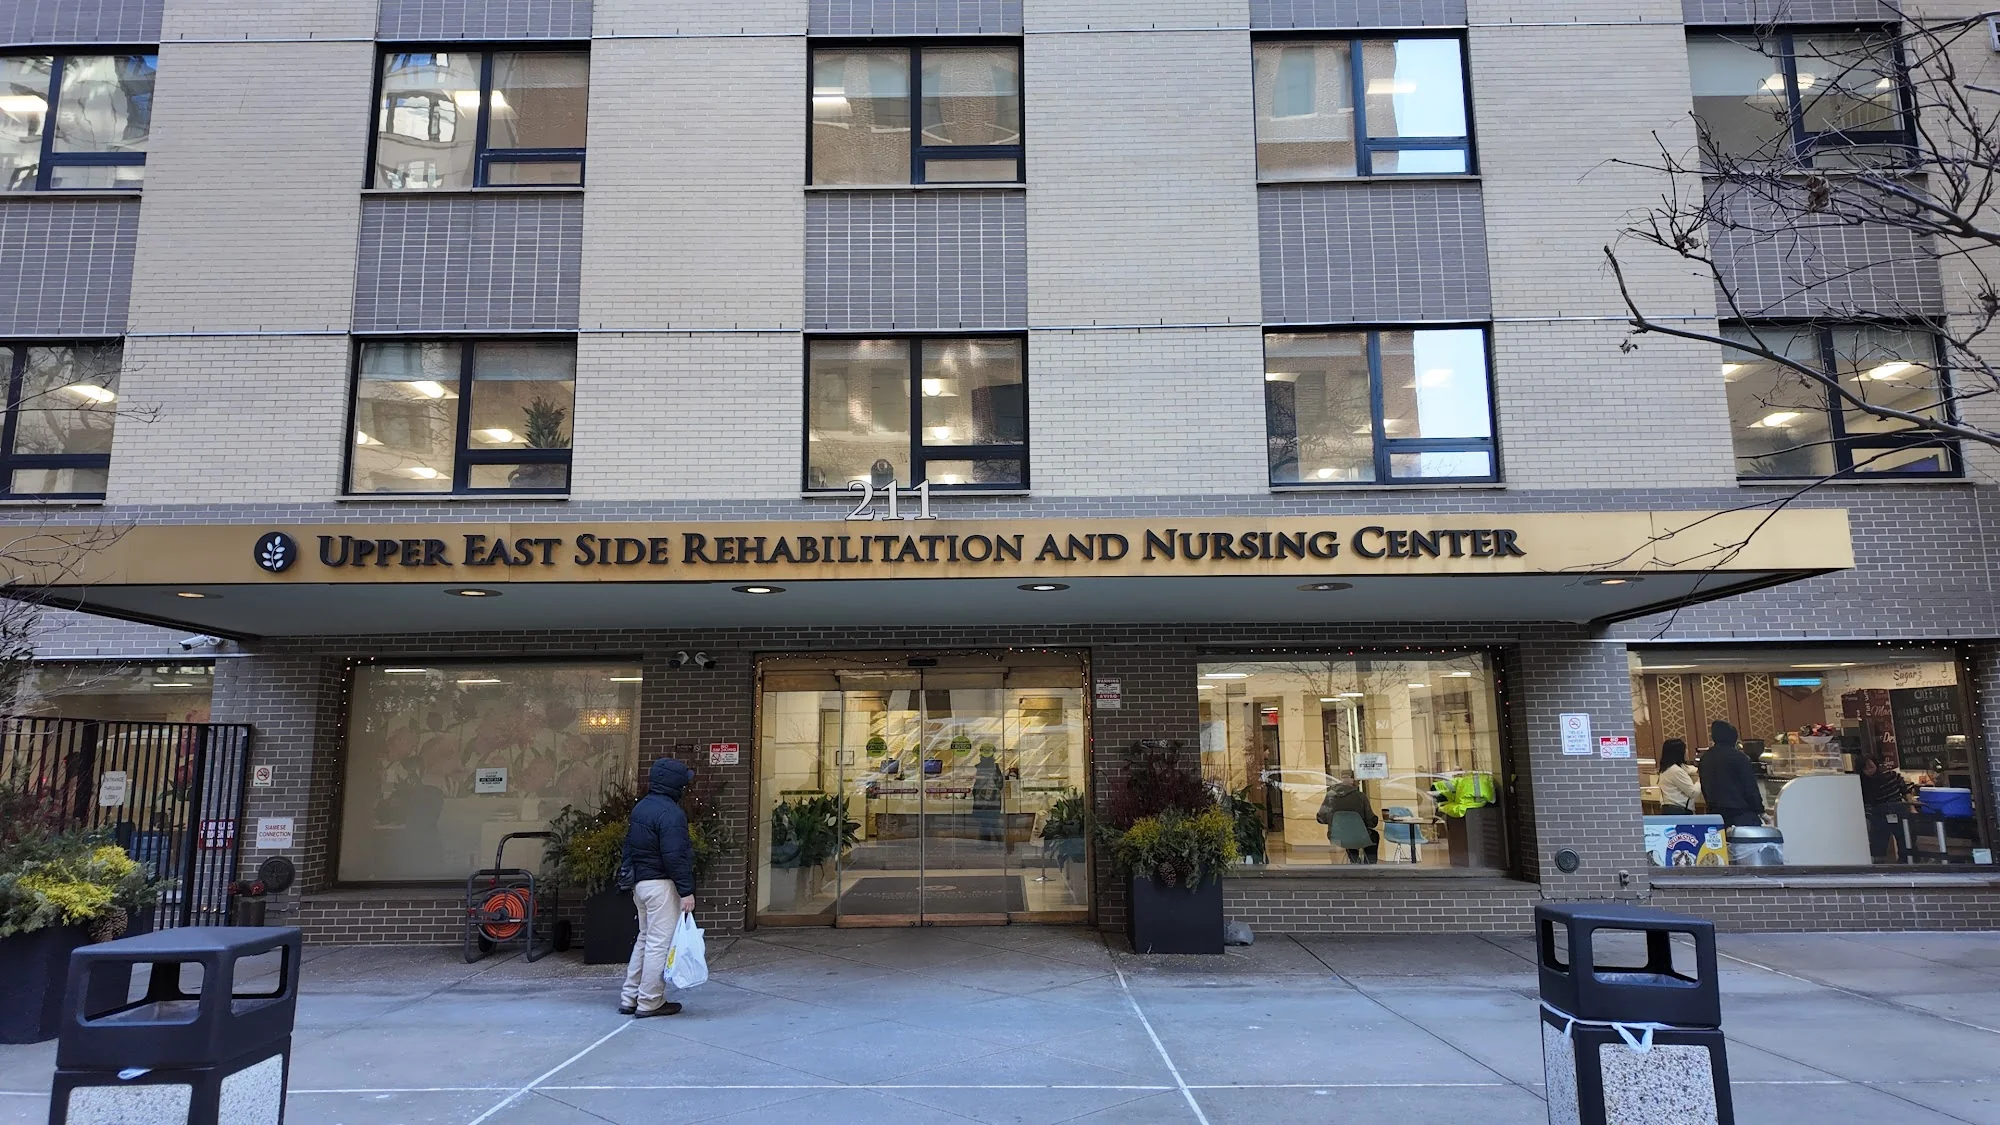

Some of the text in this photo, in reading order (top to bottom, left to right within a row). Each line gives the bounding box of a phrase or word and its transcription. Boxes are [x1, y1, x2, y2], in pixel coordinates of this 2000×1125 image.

[845, 478, 938, 522] 211
[317, 526, 1528, 569] UPPER EAST SIDE REHABILITATION AND NURSING CENTER
[1893, 669, 1917, 684] Sugar
